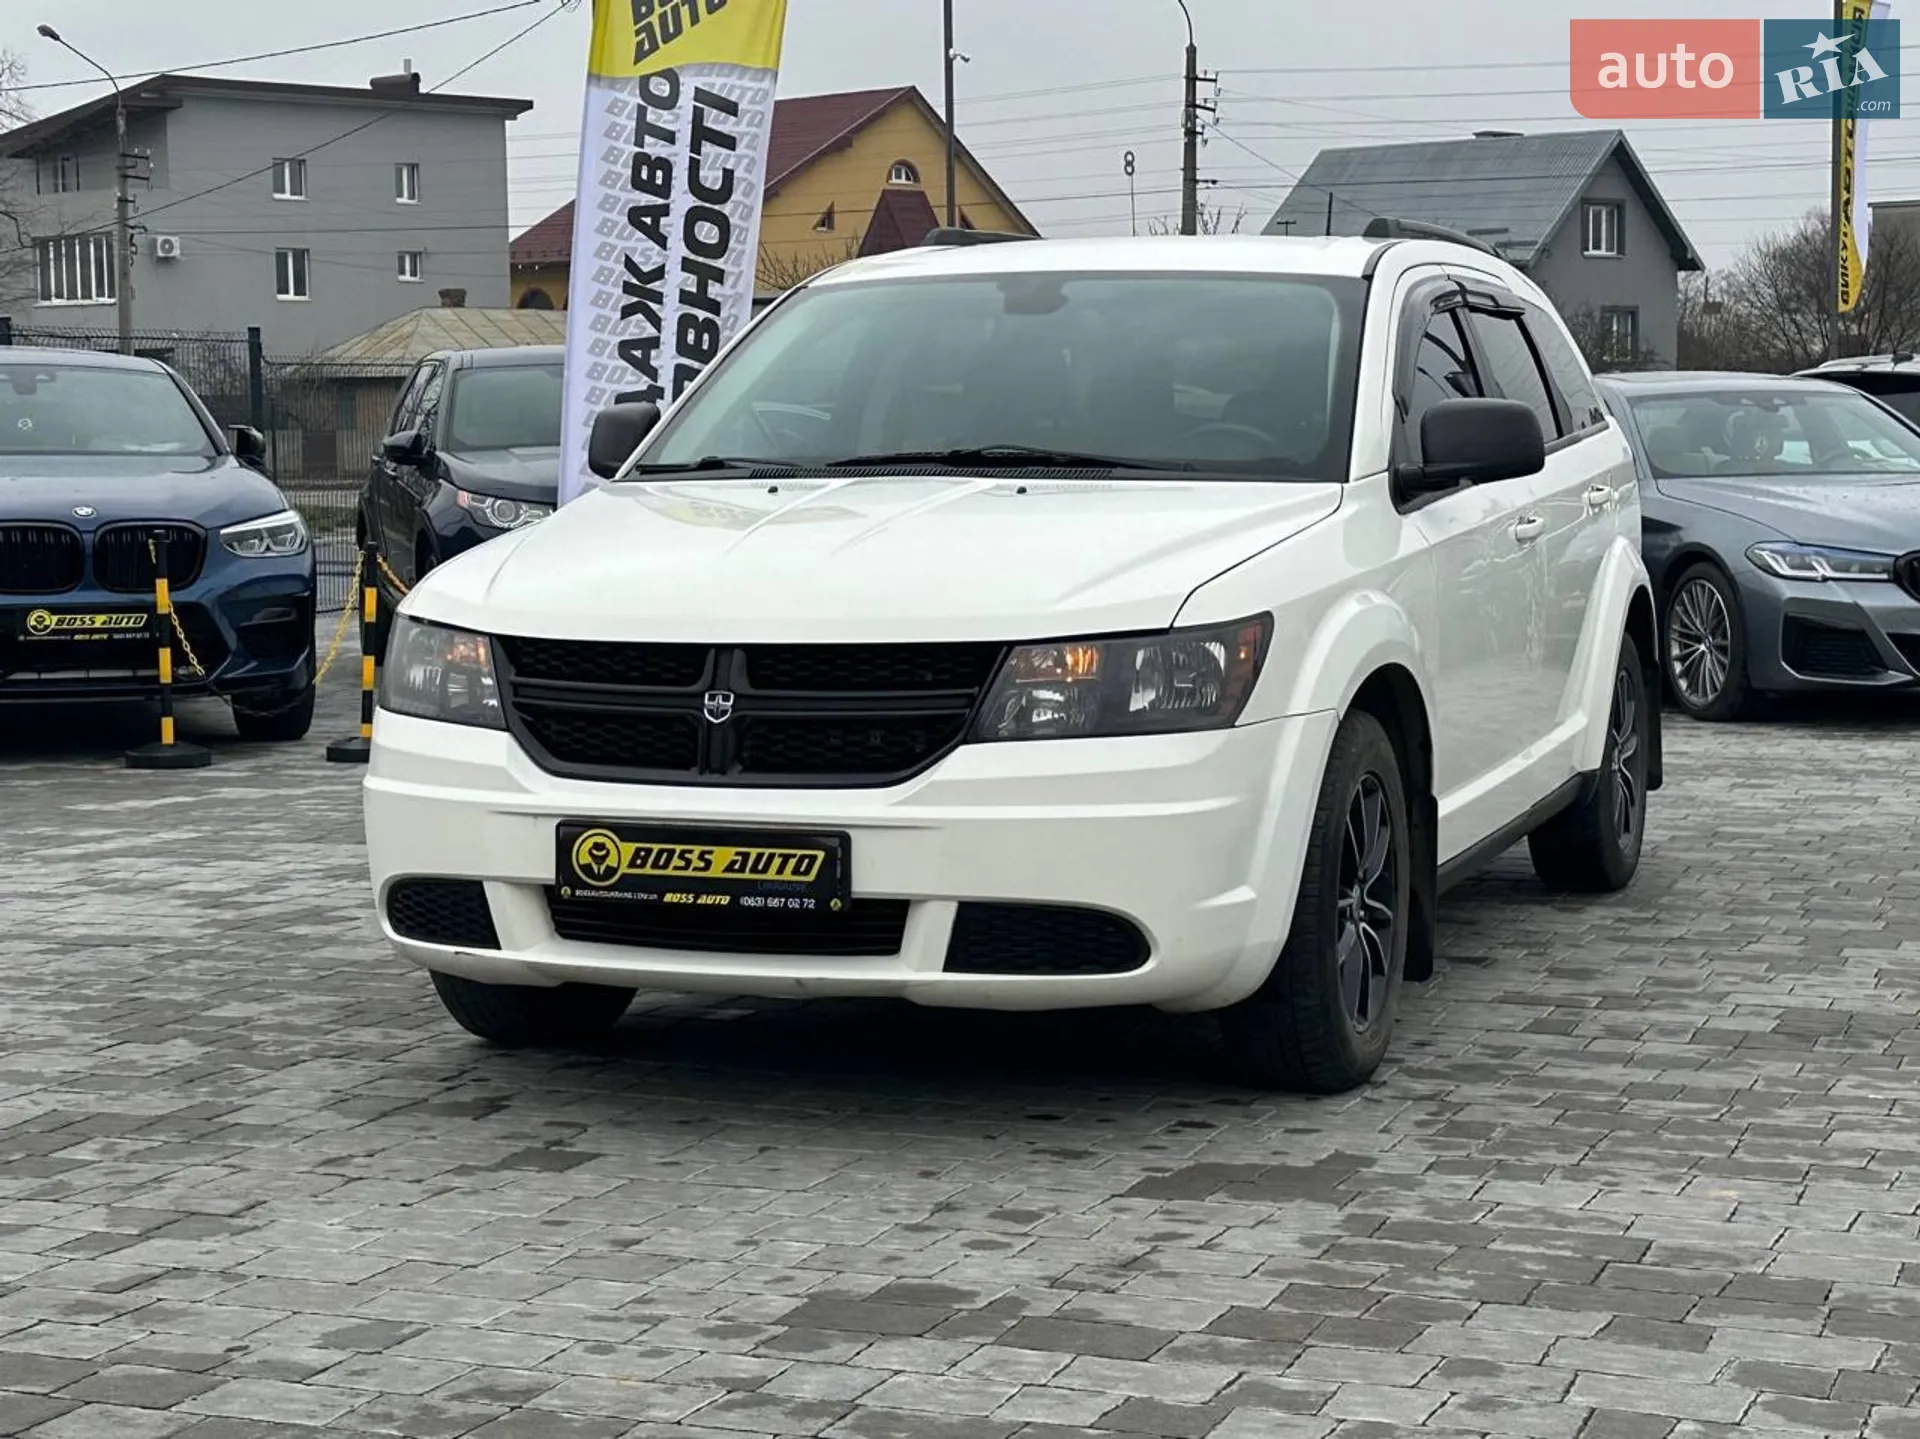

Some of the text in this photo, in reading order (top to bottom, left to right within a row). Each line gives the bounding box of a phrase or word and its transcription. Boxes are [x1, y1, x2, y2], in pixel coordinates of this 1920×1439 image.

[55, 615, 145, 627] BOSS AUTO
[628, 847, 715, 872] BOSS
[722, 851, 818, 876] AUTO
[663, 893, 694, 904] BOSS
[696, 894, 730, 905] AUTO
[788, 898, 800, 909] 02
[802, 898, 816, 909] 72
